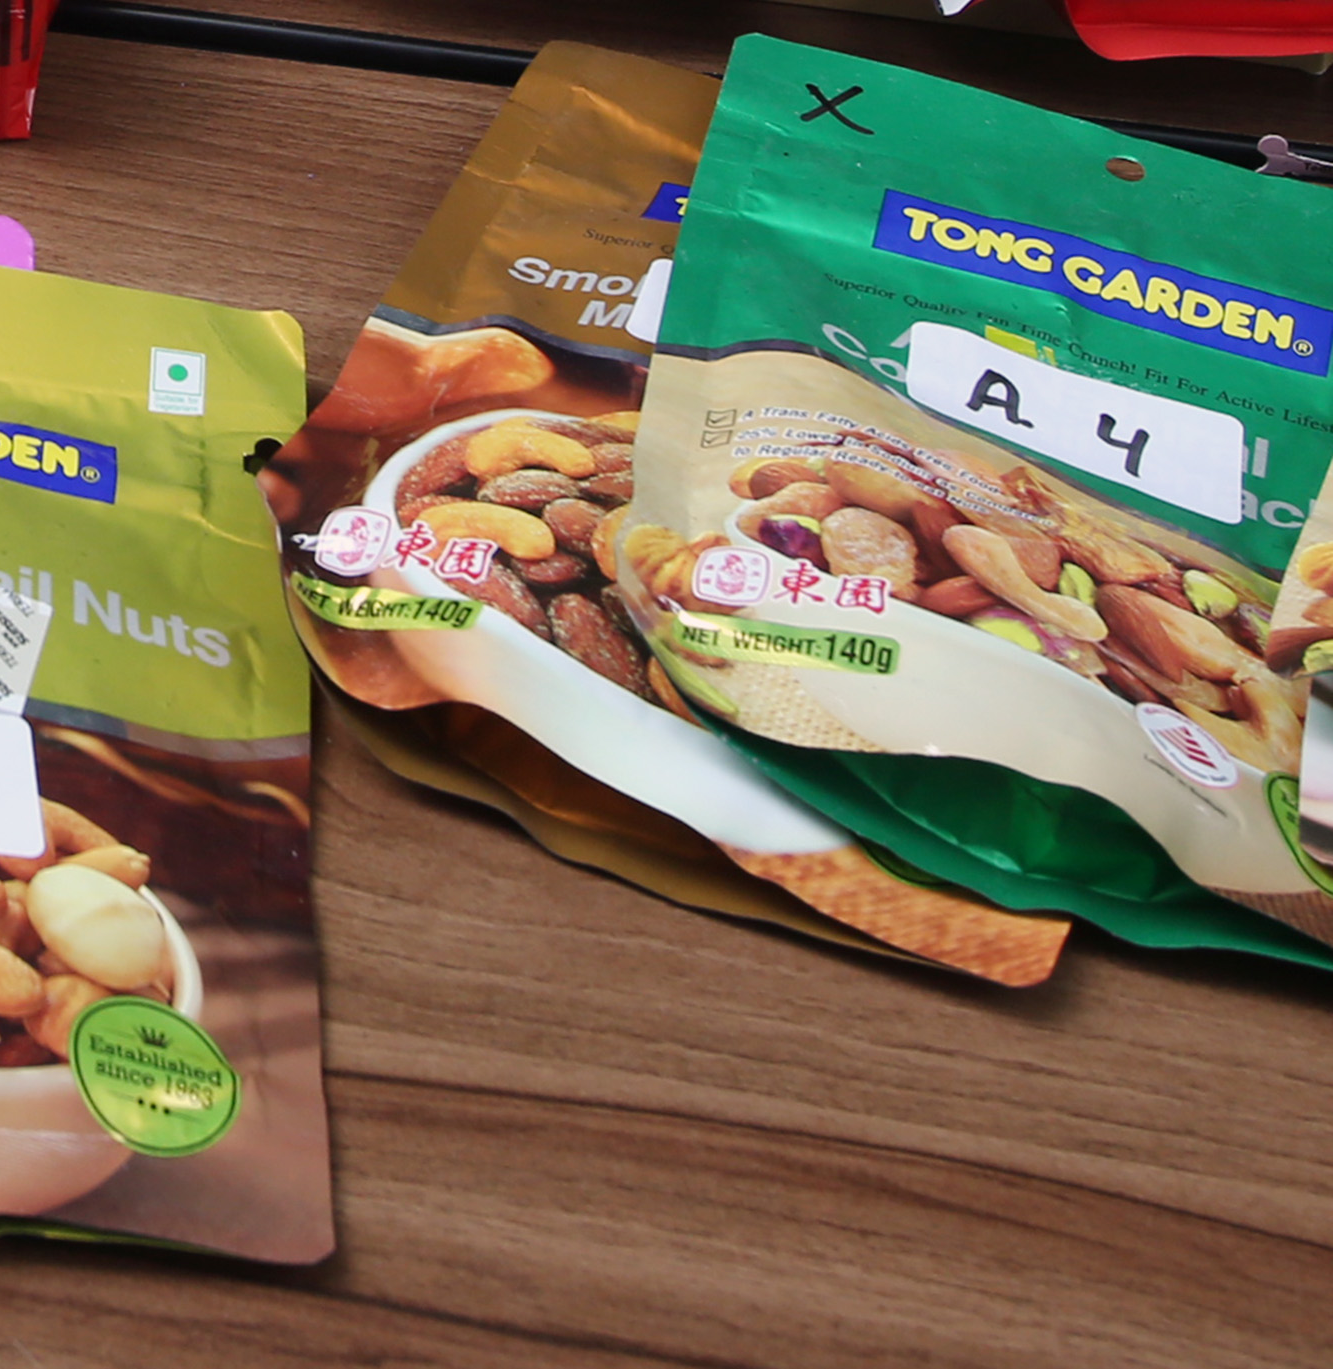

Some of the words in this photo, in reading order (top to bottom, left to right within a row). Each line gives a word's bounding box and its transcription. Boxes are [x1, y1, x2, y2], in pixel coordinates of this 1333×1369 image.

[582, 228, 653, 250] Superior
[902, 206, 1055, 273] TONG
[1063, 255, 1296, 351] GARDEN
[1069, 342, 1137, 375] Crunch!
[1145, 367, 1169, 385] Fit
[1177, 377, 1208, 397] For
[1215, 390, 1275, 416] Active
[758, 445, 828, 458] Regular
[764, 407, 808, 419] Trans
[817, 412, 858, 430] Fatty
[865, 427, 911, 450] Acids
[915, 449, 952, 472] Free
[958, 471, 1001, 495] Food
[786, 429, 841, 443] Lower
[870, 446, 935, 480] Sodium
[938, 478, 959, 491] as
[74, 578, 233, 668] Nuts
[412, 599, 473, 628] 140g
[682, 626, 722, 647] NET
[732, 629, 822, 658] WEIGHT:
[823, 632, 894, 674] 140g
[90, 1034, 222, 1088] Established
[95, 1060, 155, 1087] since
[166, 1074, 214, 1110] 1963
